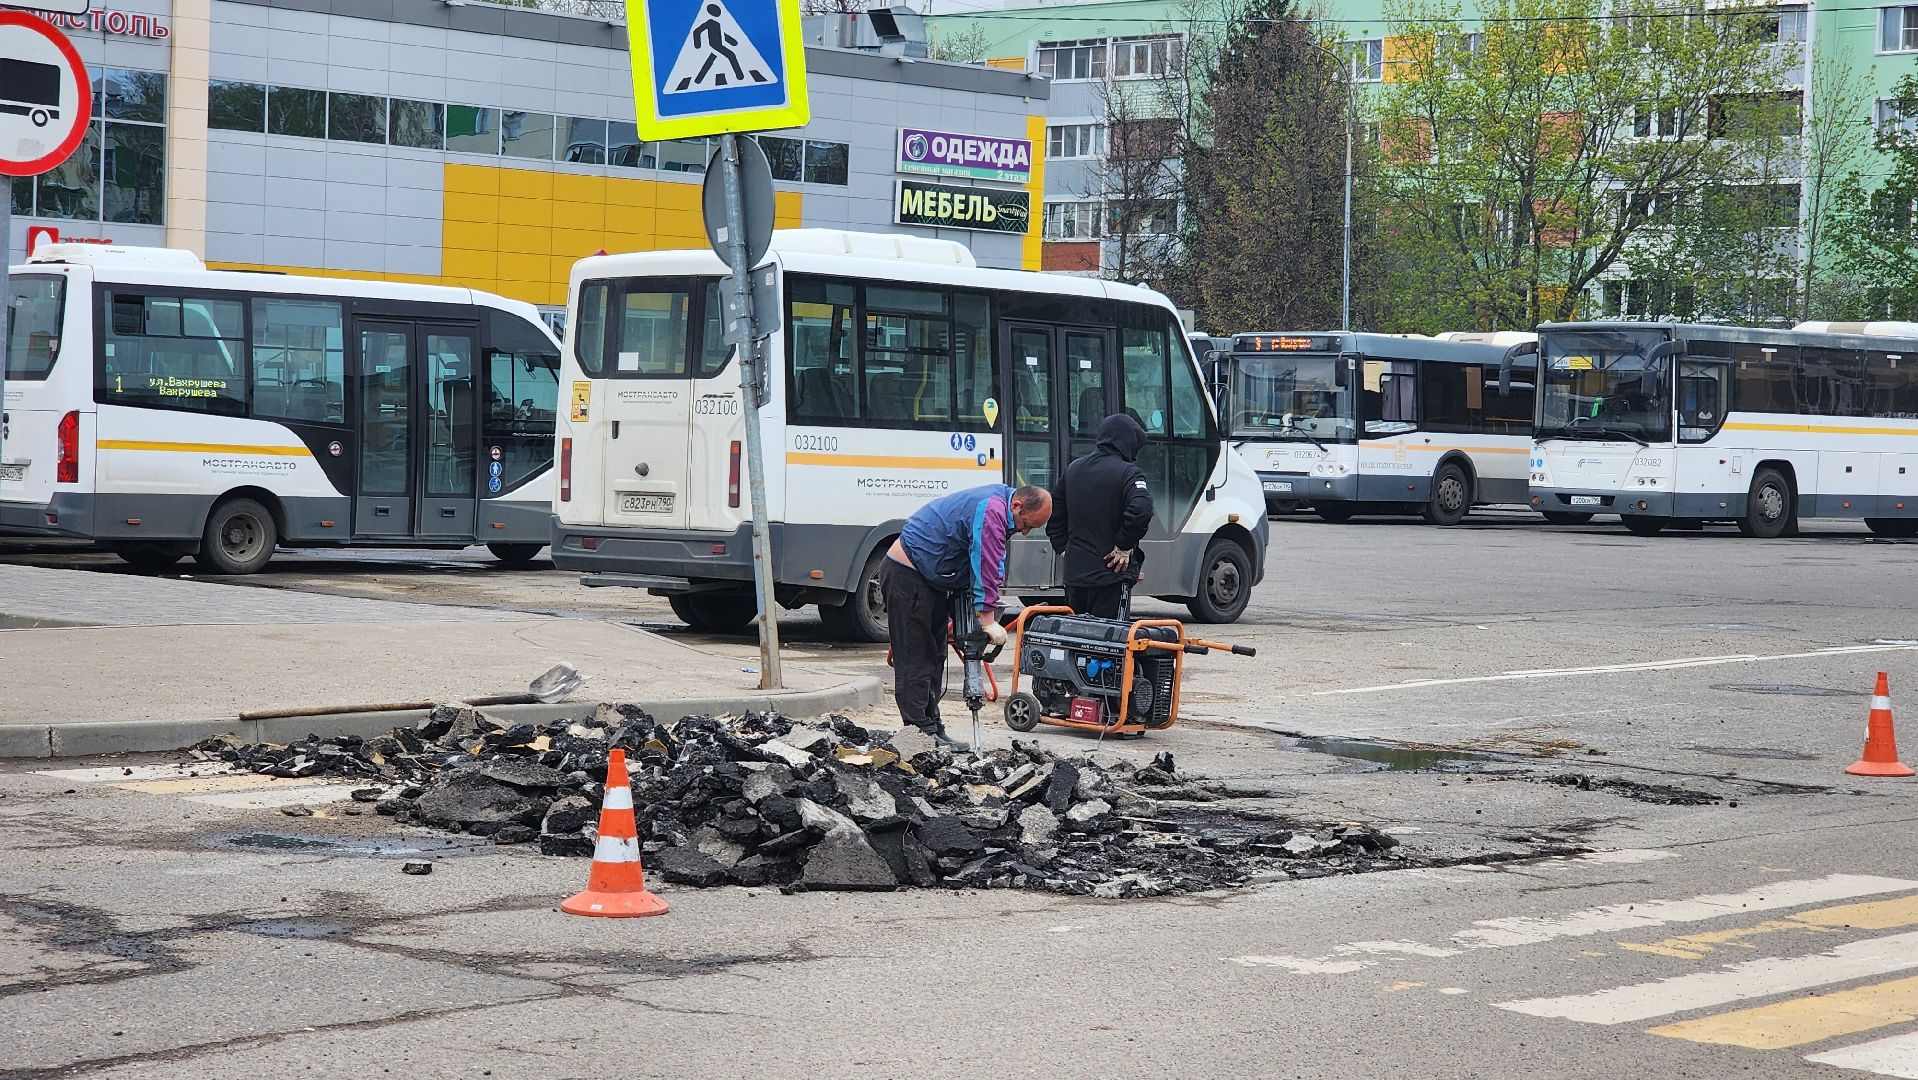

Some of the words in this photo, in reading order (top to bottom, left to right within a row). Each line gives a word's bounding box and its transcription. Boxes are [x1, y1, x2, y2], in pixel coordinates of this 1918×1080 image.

[931, 136, 1029, 169] ОДЕЖДА
[902, 188, 997, 222] МЕБЕЛЬ
[115, 375, 124, 393] 1
[149, 376, 227, 389] ул.Вахрушева
[159, 387, 218, 398] Вахрушева
[617, 391, 678, 399] МОСТРАНСАВТО
[695, 399, 738, 416] 032100
[795, 434, 838, 451] 032100
[1294, 450, 1317, 459] 032067
[202, 458, 296, 470] МОСТРАНСАВТО
[1634, 458, 1662, 467] 032082
[857, 477, 949, 490] МОСТРАНСАВТО
